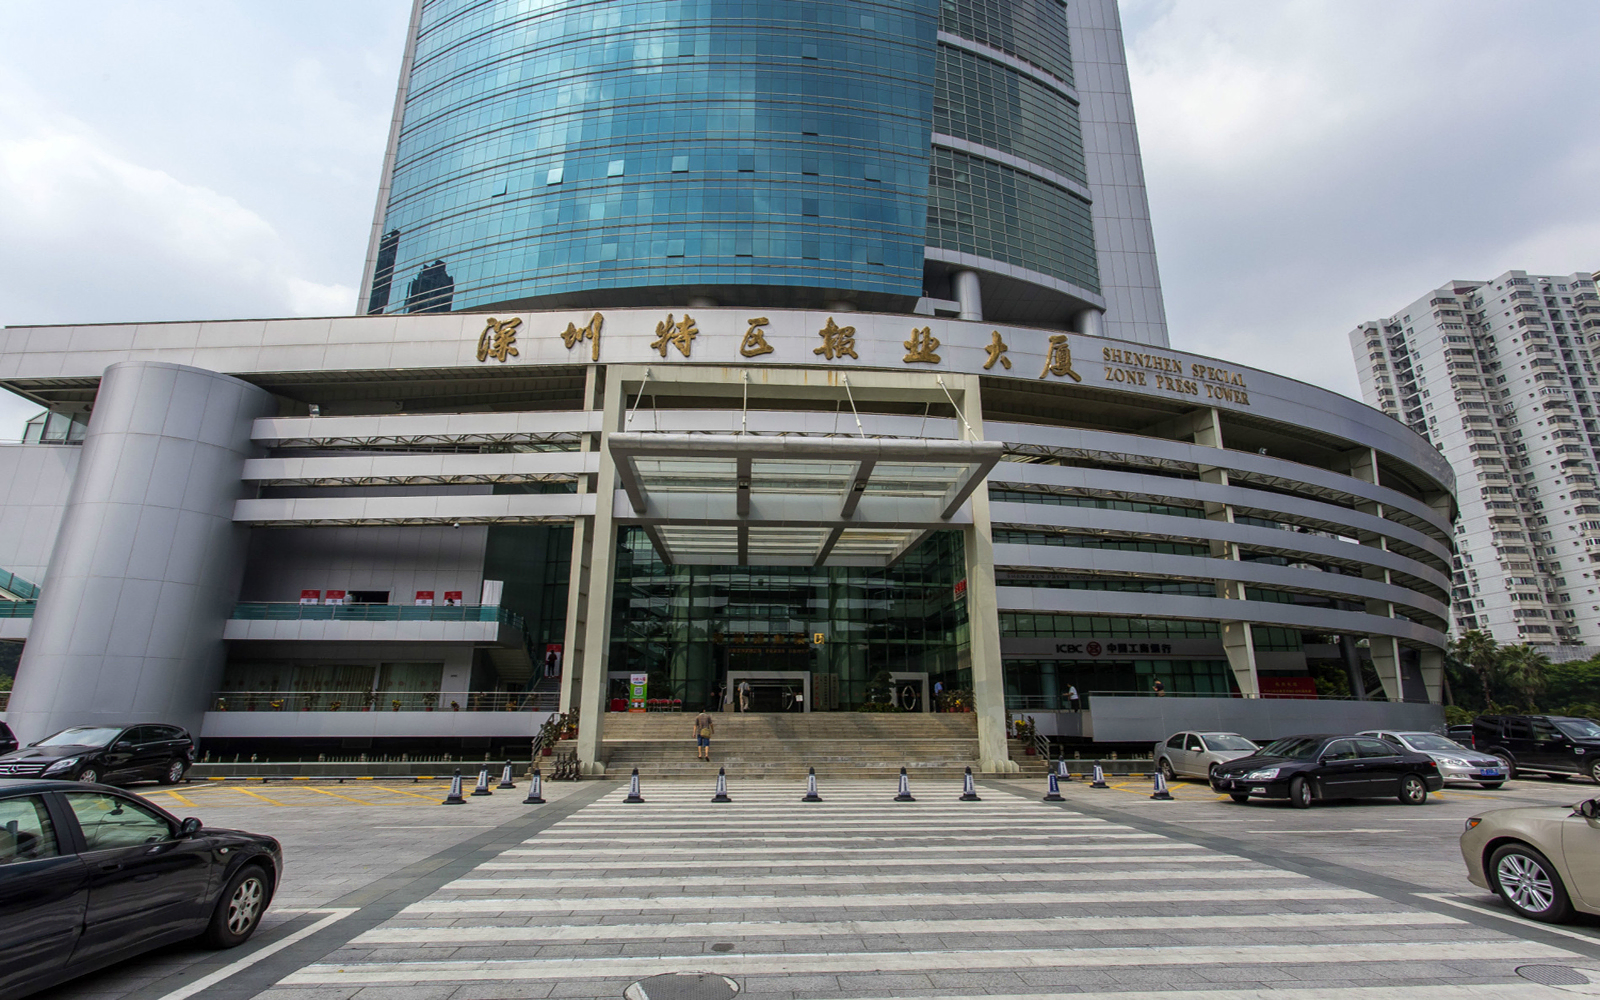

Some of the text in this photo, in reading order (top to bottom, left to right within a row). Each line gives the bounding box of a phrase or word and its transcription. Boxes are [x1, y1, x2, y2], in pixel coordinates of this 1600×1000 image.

[477, 311, 1082, 383] 深圳特区报业大厦
[1102, 347, 1247, 388] SHENZHEN SPECIAL
[1104, 366, 1251, 406] ZONE PRESS TOWER
[1056, 644, 1083, 654] ICBC
[1106, 643, 1172, 654] 中国工商银行
